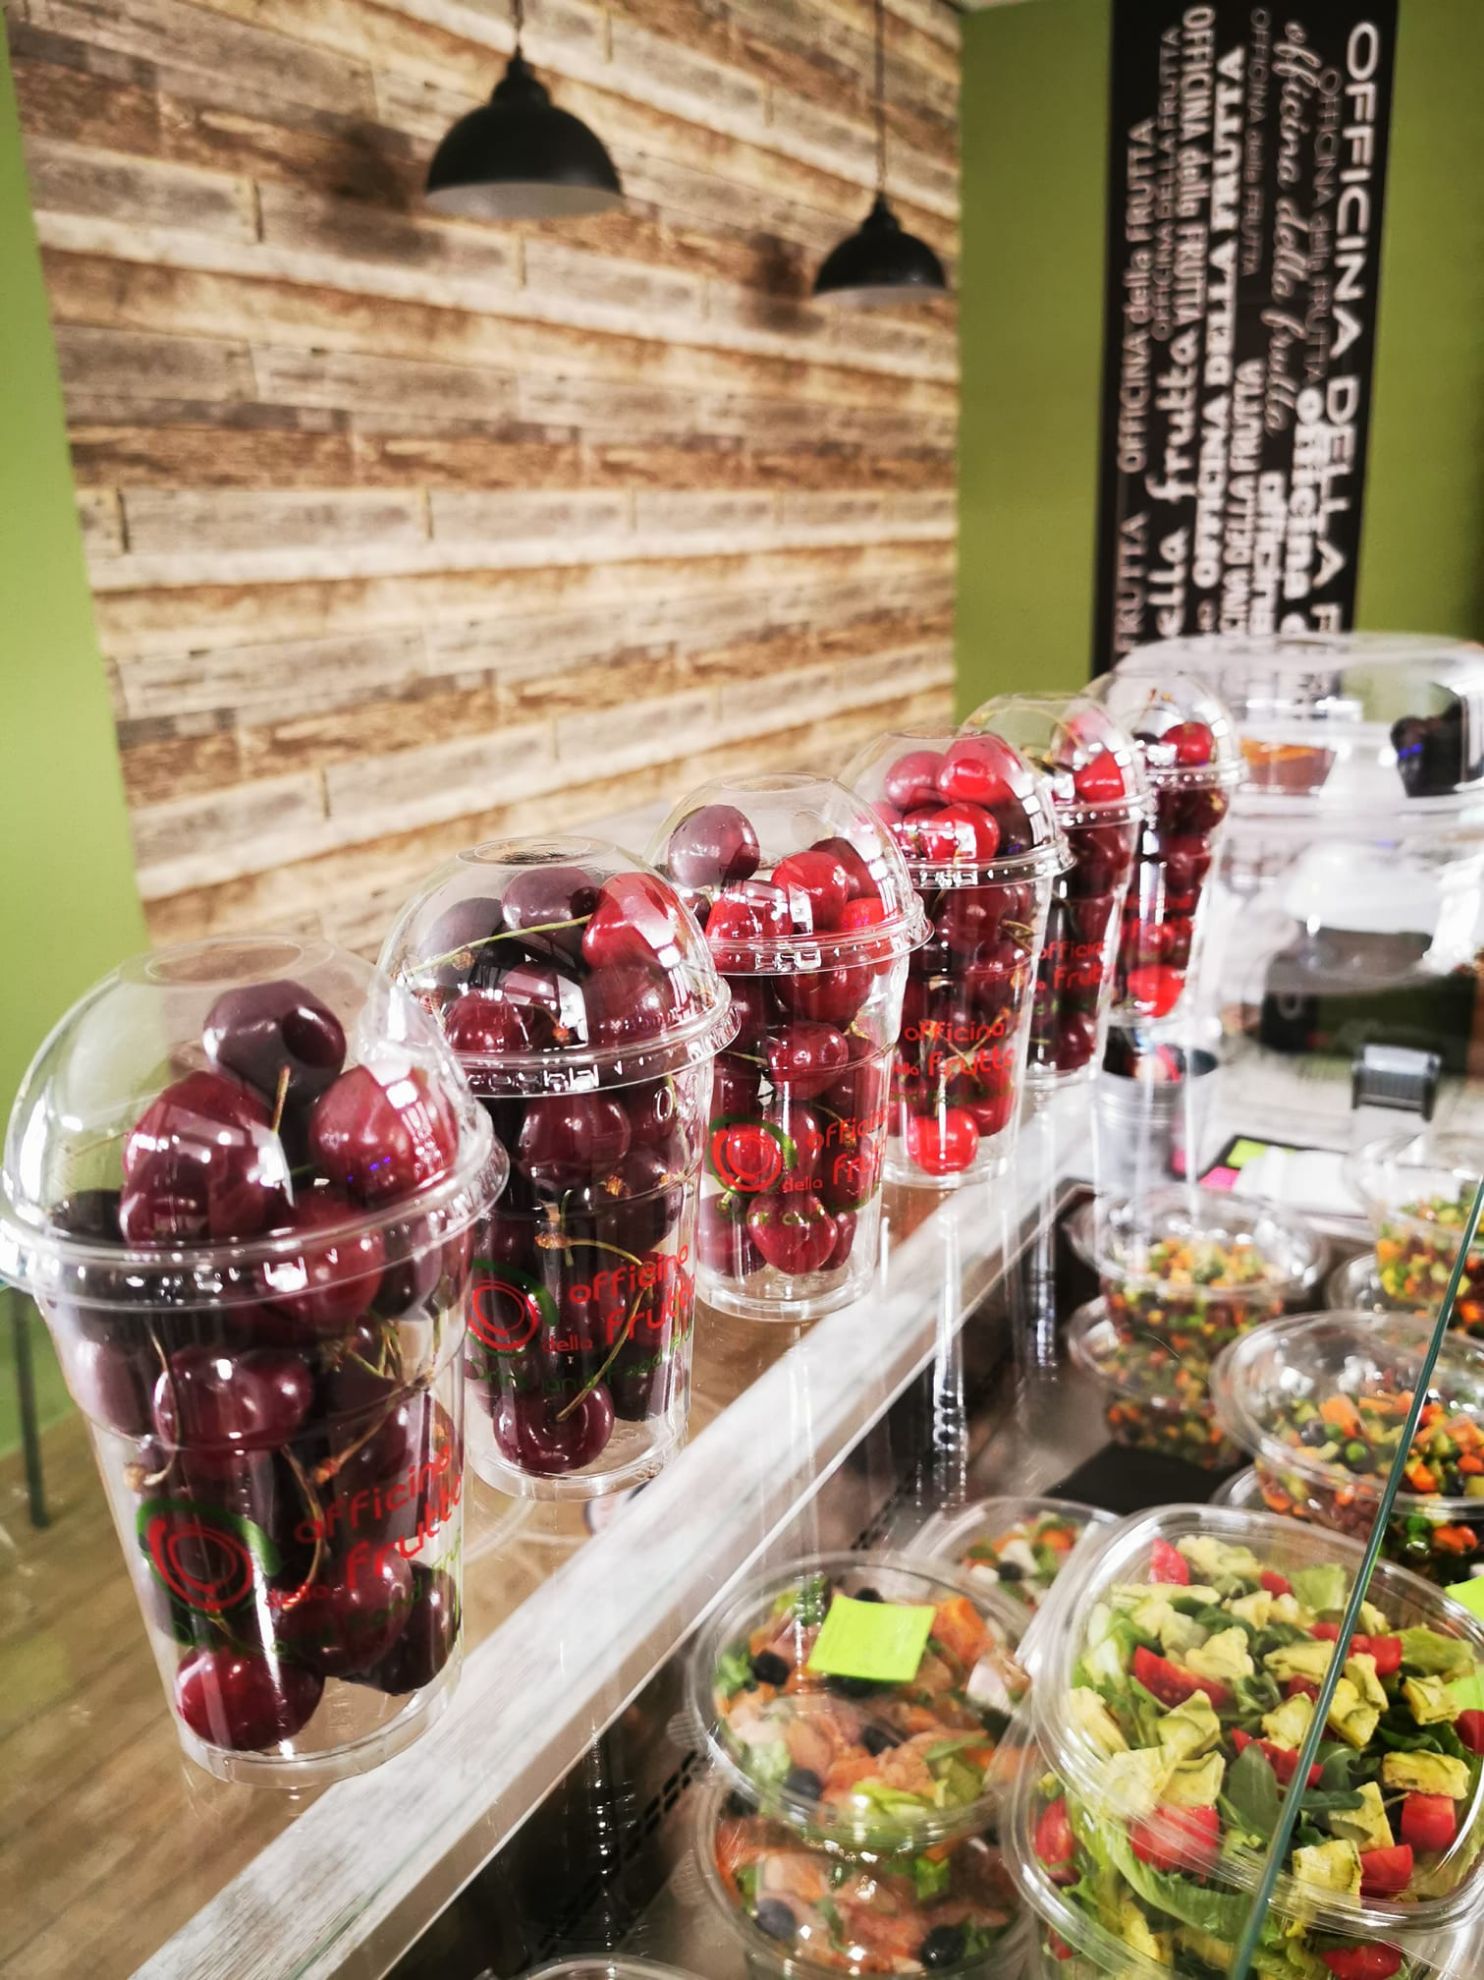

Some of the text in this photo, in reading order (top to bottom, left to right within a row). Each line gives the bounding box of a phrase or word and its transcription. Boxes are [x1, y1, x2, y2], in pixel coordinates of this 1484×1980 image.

[1180, 7, 1216, 141] OFFICINA
[1248, 8, 1271, 123] OFFICINA
[1272, 22, 1322, 190] officina
[1125, 118, 1158, 242] FRUTTA
[1211, 47, 1245, 231] FRUTTA
[1329, 22, 1380, 359] OFFICINA
[1173, 221, 1208, 327] FRUTTA
[1204, 239, 1237, 388] DELLA
[1117, 330, 1150, 473] OFFICINA
[1145, 328, 1199, 638] ella frutta
[1193, 394, 1229, 589] OFFICINA
[1312, 375, 1361, 588] DELLA
[542, 1334, 593, 1353] della
[569, 1244, 689, 1305] officina
[294, 1444, 452, 1543] officina
